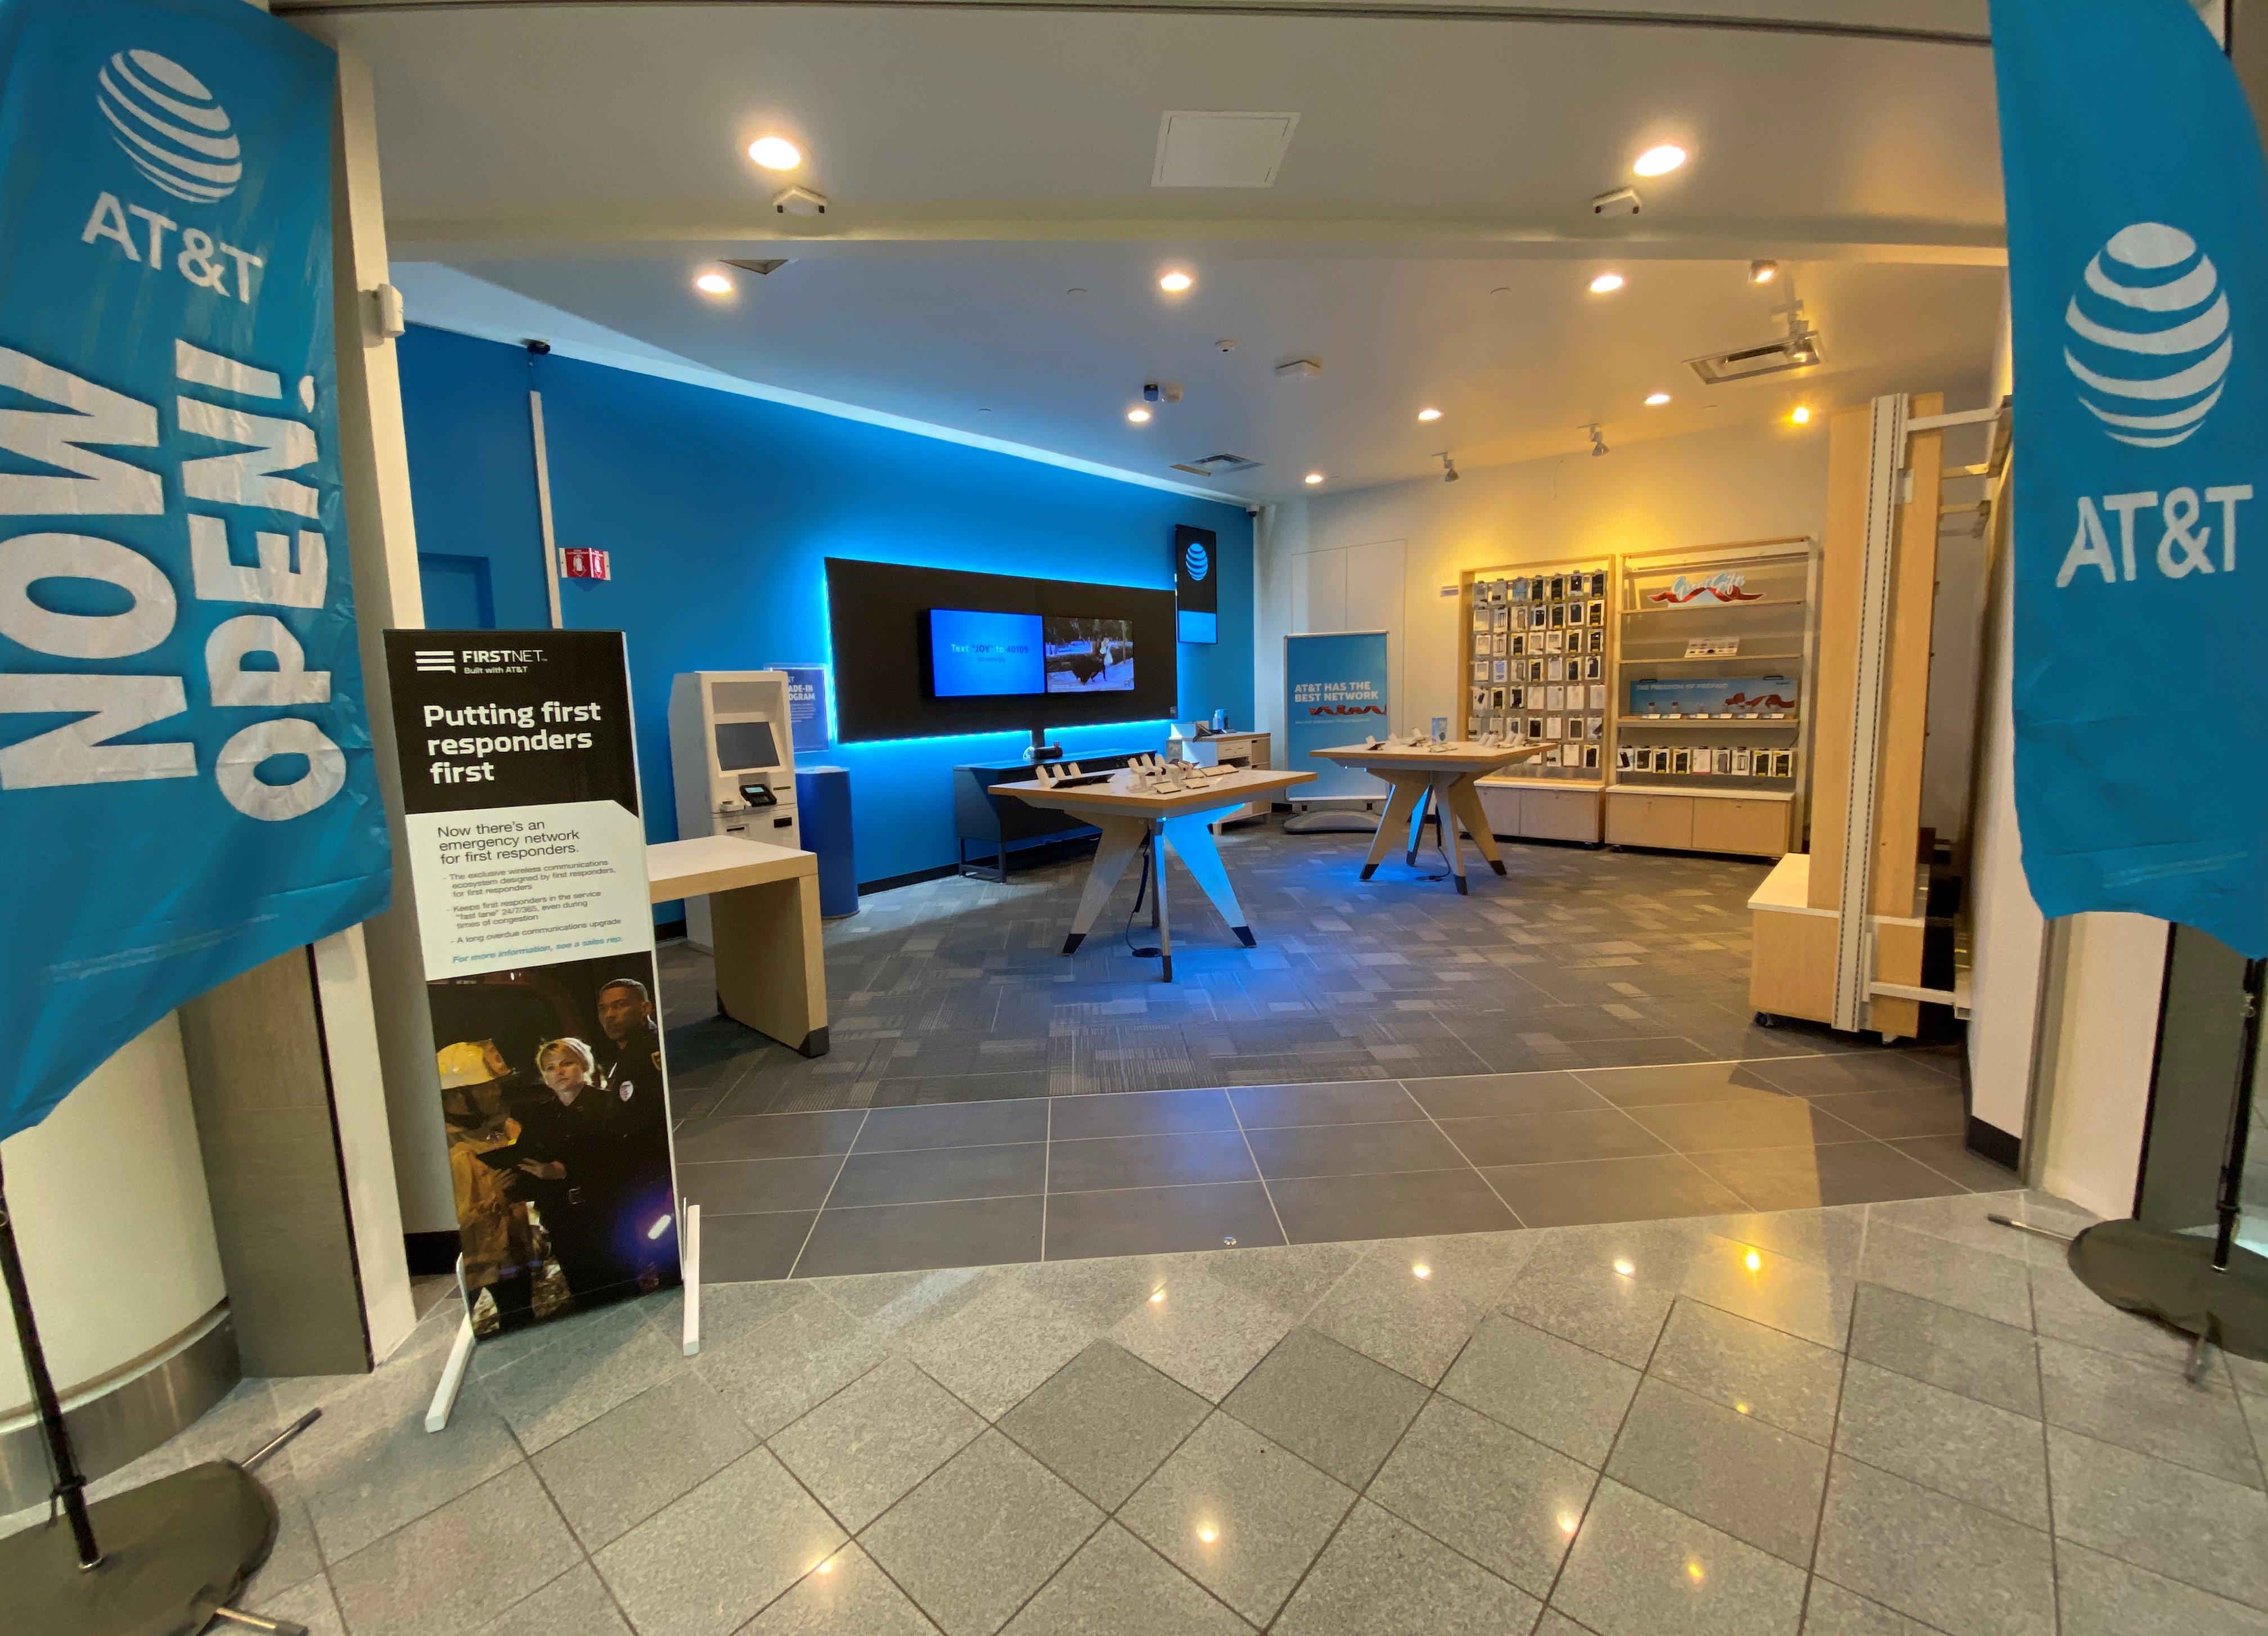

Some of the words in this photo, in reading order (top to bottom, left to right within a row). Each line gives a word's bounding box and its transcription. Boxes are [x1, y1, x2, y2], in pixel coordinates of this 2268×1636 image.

[82, 191, 263, 304] AT&T
[2055, 484, 2253, 588] AT&T
[0, 345, 198, 790] NOW
[175, 337, 346, 821] OPEN!
[951, 644, 969, 652] Text
[788, 684, 813, 693] ADE-IN
[1295, 683, 1321, 692] AT&T
[1324, 682, 1347, 691] HAS
[1349, 681, 1371, 690] THE
[1295, 693, 1321, 702] BEST
[1324, 691, 1378, 701] NETWORK
[424, 703, 535, 728] Putting
[541, 701, 601, 723] first
[428, 729, 593, 758] responders
[430, 761, 495, 785] first
[438, 826, 471, 838] Now
[476, 821, 524, 835] there's
[528, 821, 545, 831] an
[439, 836, 520, 851] emergency
[525, 830, 580, 844] network
[440, 853, 460, 865] for
[465, 850, 492, 863] first
[497, 844, 579, 860] responders.
[452, 879, 498, 890] ecosystem
[500, 874, 538, 885] designed
[540, 873, 550, 881] by
[569, 867, 616, 878] responders,
[468, 869, 506, 879] exclusive
[509, 866, 541, 875] wireless
[543, 859, 609, 872] communications
[485, 883, 533, 895] responders
[453, 904, 480, 913] Keeps
[500, 896, 547, 908] responders
[573, 891, 602, 900] service
[542, 903, 561, 911] even
[563, 899, 588, 909] during
[457, 921, 480, 929] times
[493, 913, 539, 926] congestion
[466, 935, 484, 944] long
[487, 930, 520, 940] overdue
[521, 922, 588, 936] communications
[589, 917, 622, 929] upgrade
[452, 955, 469, 964] For
[470, 952, 496, 961] more
[498, 944, 554, 958] information,
[556, 941, 573, 950] see
[582, 938, 605, 947] sales
